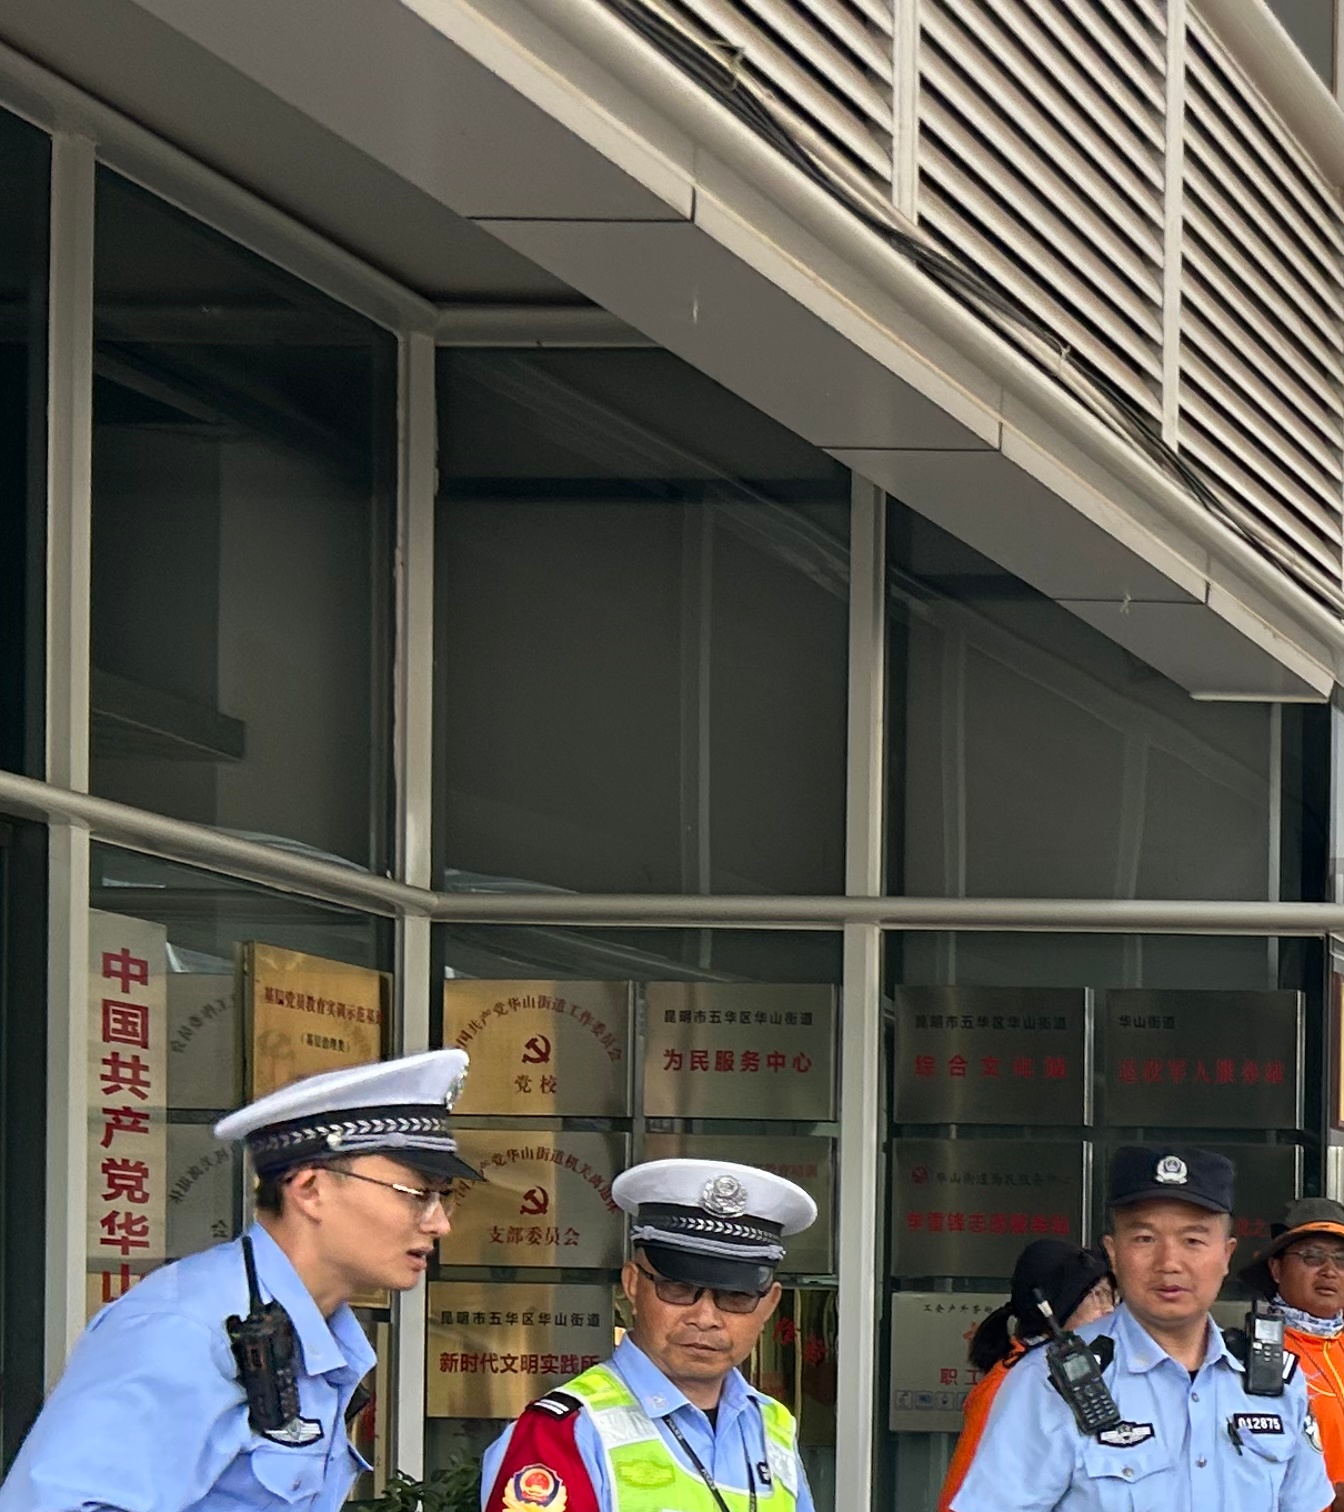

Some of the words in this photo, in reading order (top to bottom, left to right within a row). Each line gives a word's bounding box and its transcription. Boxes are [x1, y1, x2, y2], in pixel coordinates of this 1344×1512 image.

[453, 993, 624, 1065] 国共产党华山街道工作委员会
[662, 1008, 815, 1028] 昆明市五华区华山街道
[1117, 1014, 1177, 1030] 华山街道
[662, 1048, 815, 1075] 为民服务中心
[513, 1074, 559, 1095] 党校
[99, 947, 151, 1304] 中国共产党华山
[488, 1225, 581, 1248] 支部委员会
[440, 1309, 603, 1328] 昆明市五华区华山街道
[439, 1348, 603, 1375] 新时代文明实践所
